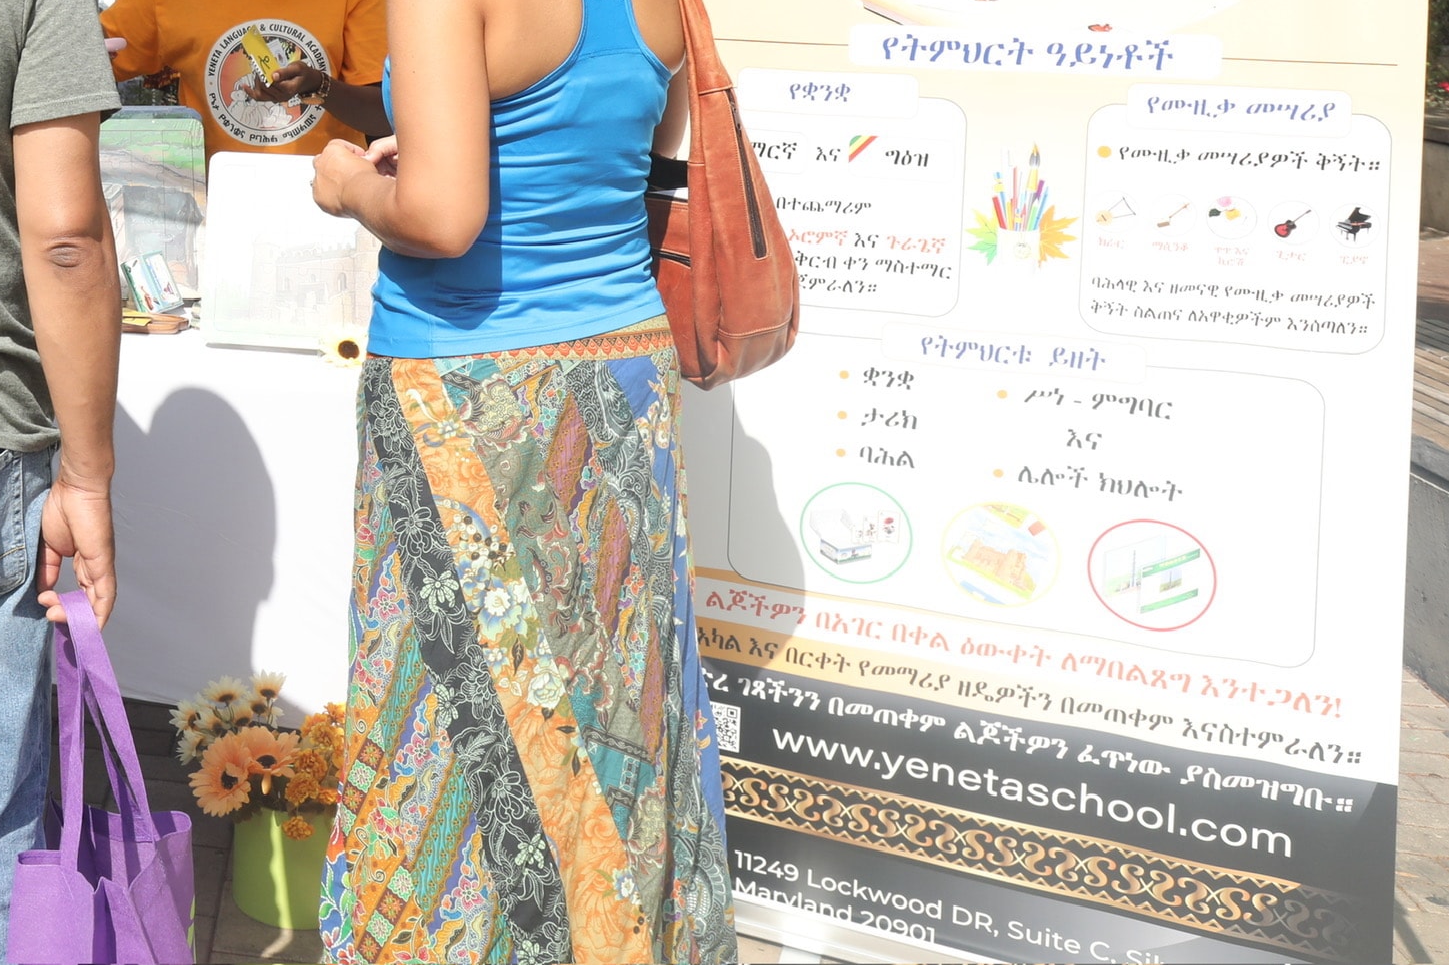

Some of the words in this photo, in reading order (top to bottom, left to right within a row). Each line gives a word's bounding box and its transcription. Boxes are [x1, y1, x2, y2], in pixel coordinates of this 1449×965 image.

[208, 48, 223, 76] YENETA
[269, 23, 307, 42] CULTURAL
[305, 41, 327, 74] ACADEMY
[882, 34, 1033, 66] የትምህርት
[1046, 40, 1173, 70] ዓይነቶች
[789, 82, 851, 102] የቋንቋ
[1147, 96, 1236, 118] የሙዚቃ
[1246, 102, 1336, 122] መሣሪያ
[816, 147, 841, 162] እና
[885, 150, 929, 167] ግዕዝ
[1119, 146, 1190, 164] የሙዚቃ
[1198, 151, 1308, 170] መሣሪያዎች
[854, 233, 880, 248] እና
[843, 258, 868, 271] ቀን
[875, 258, 952, 280] ማስተማር
[1143, 280, 1164, 293] እና
[1225, 285, 1284, 304] የሙዚቃ
[920, 335, 1032, 364] የትምህርቱ
[1049, 347, 1106, 372] ይዘት
[863, 367, 915, 390] ቋንቋ
[1024, 388, 1065, 406] ሥነ
[1091, 393, 1173, 420] ምግባር
[861, 408, 918, 430] ታሪክ
[1066, 429, 1102, 450] እና
[859, 445, 915, 469] ባሕል
[1018, 466, 1088, 489] ሌሎች
[1098, 472, 1183, 502] ክህሎት
[706, 589, 807, 625] ልጆችዎን
[815, 611, 884, 640] በአገር
[891, 622, 950, 652] በቀል
[960, 637, 1052, 668] ዕውቀት
[749, 637, 780, 660] እና
[786, 646, 851, 674] በርቀት
[858, 659, 951, 692] የመማሪያ
[957, 679, 1052, 712] ዘዴዎችን
[1060, 696, 1174, 732] በመጠቀም
[828, 696, 946, 732] በመጠቀም
[953, 719, 1068, 760] ልጆችዎን
[1077, 744, 1171, 776] ፈጥነው
[772, 728, 1294, 858] www.yenetaschool.com
[734, 849, 799, 882] 11249
[807, 868, 943, 920] Lockwood
[952, 905, 999, 938] DR,
[1008, 920, 1081, 955] Suite
[735, 877, 852, 922] Maryland
[860, 911, 936, 944] 20901
